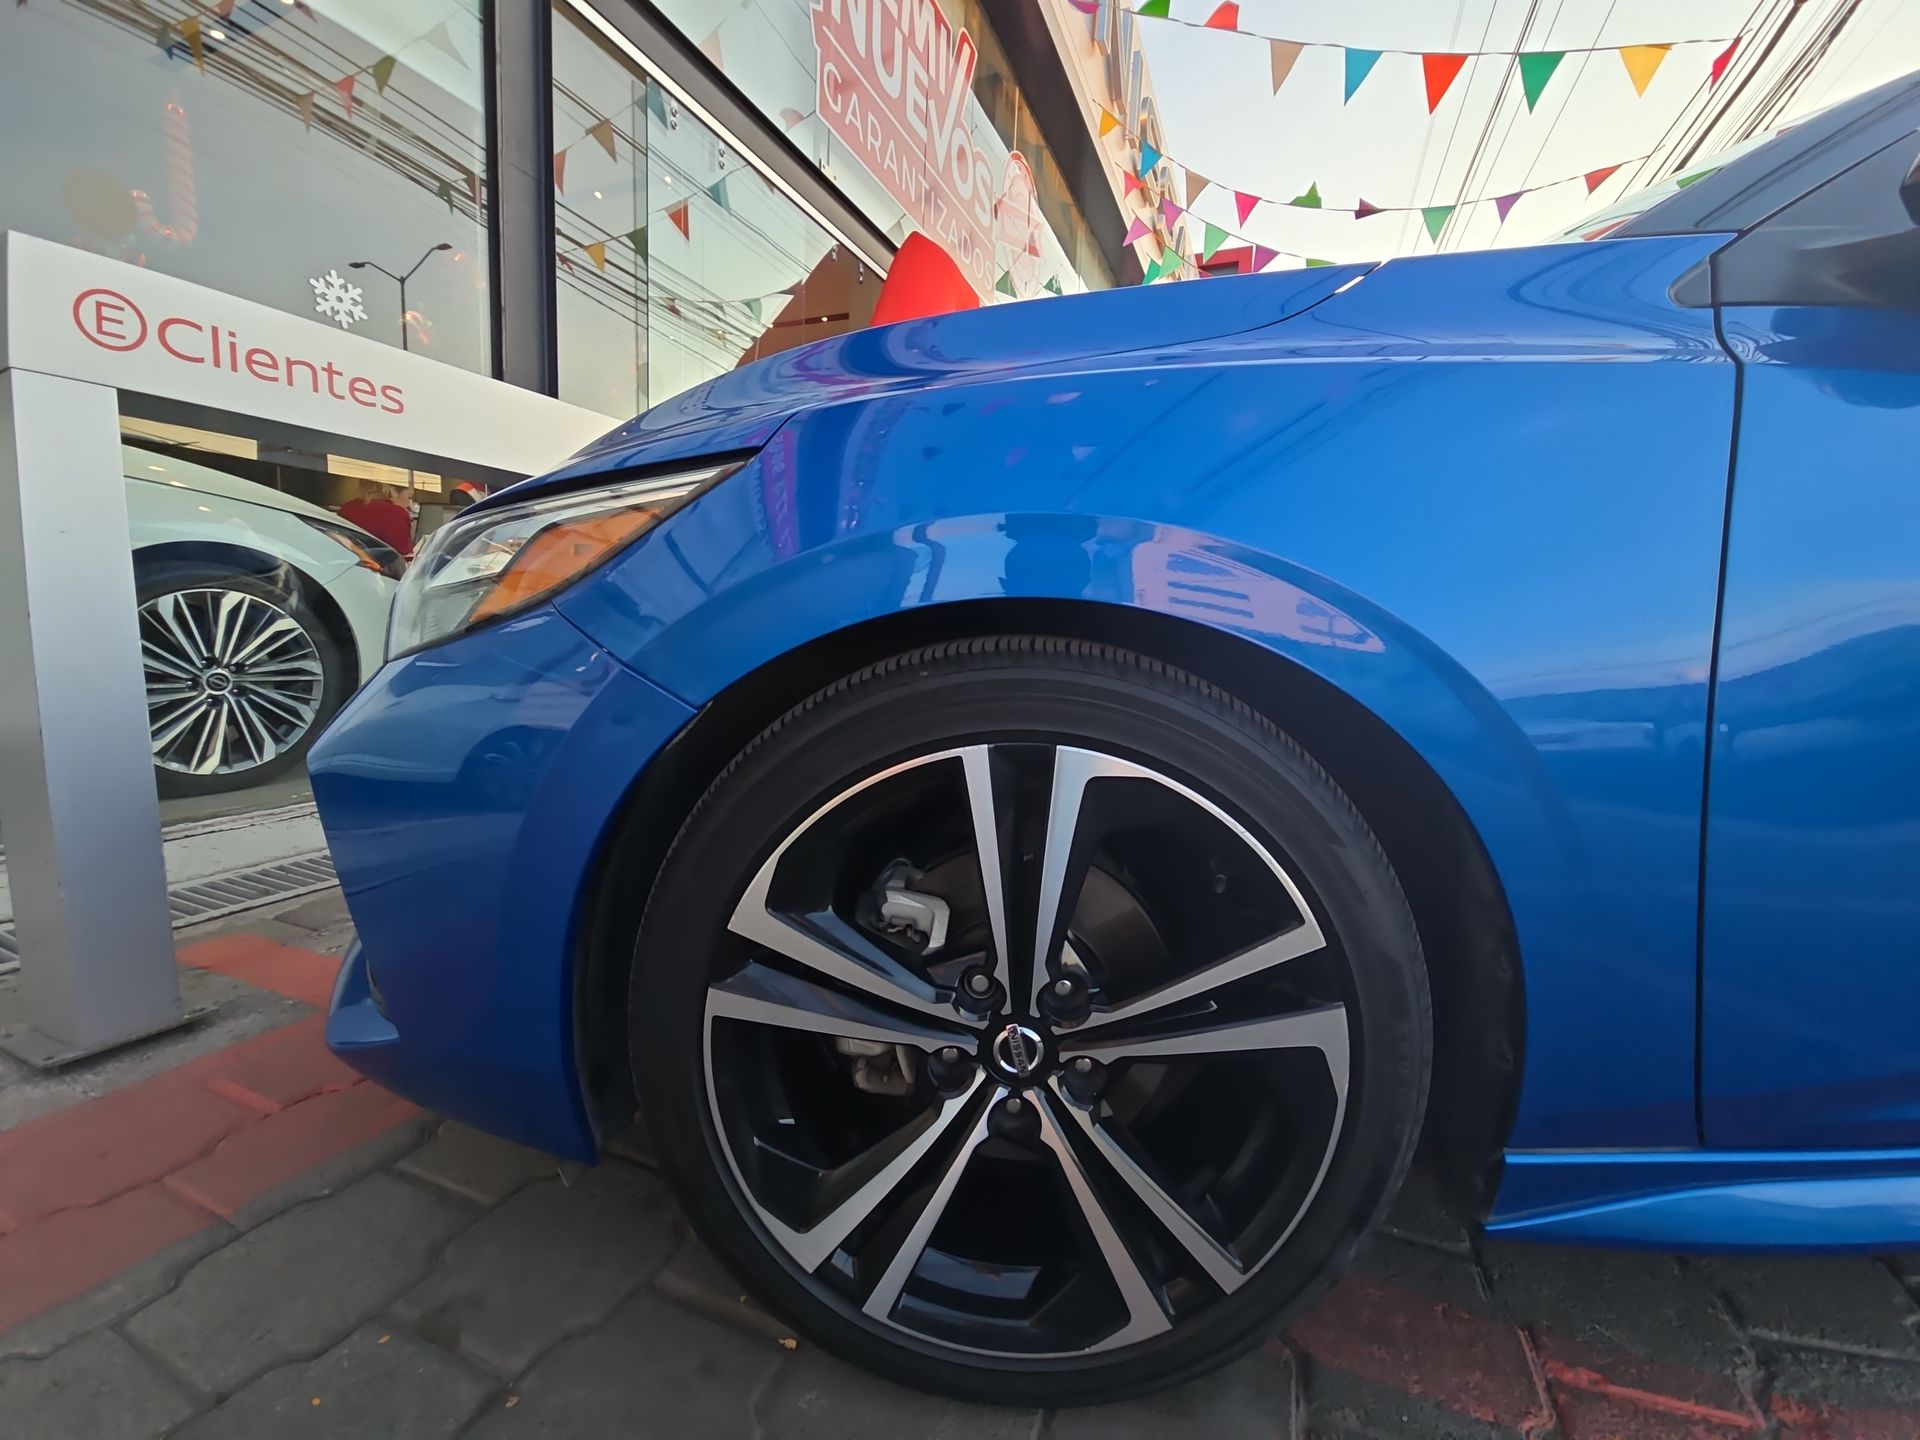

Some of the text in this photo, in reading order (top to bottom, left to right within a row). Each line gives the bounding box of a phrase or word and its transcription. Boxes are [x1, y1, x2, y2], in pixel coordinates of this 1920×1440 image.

[823, 62, 992, 291] GARANTIZADOS
[157, 317, 405, 414] Clientes
[1006, 1025, 1029, 1075] NISSAN
